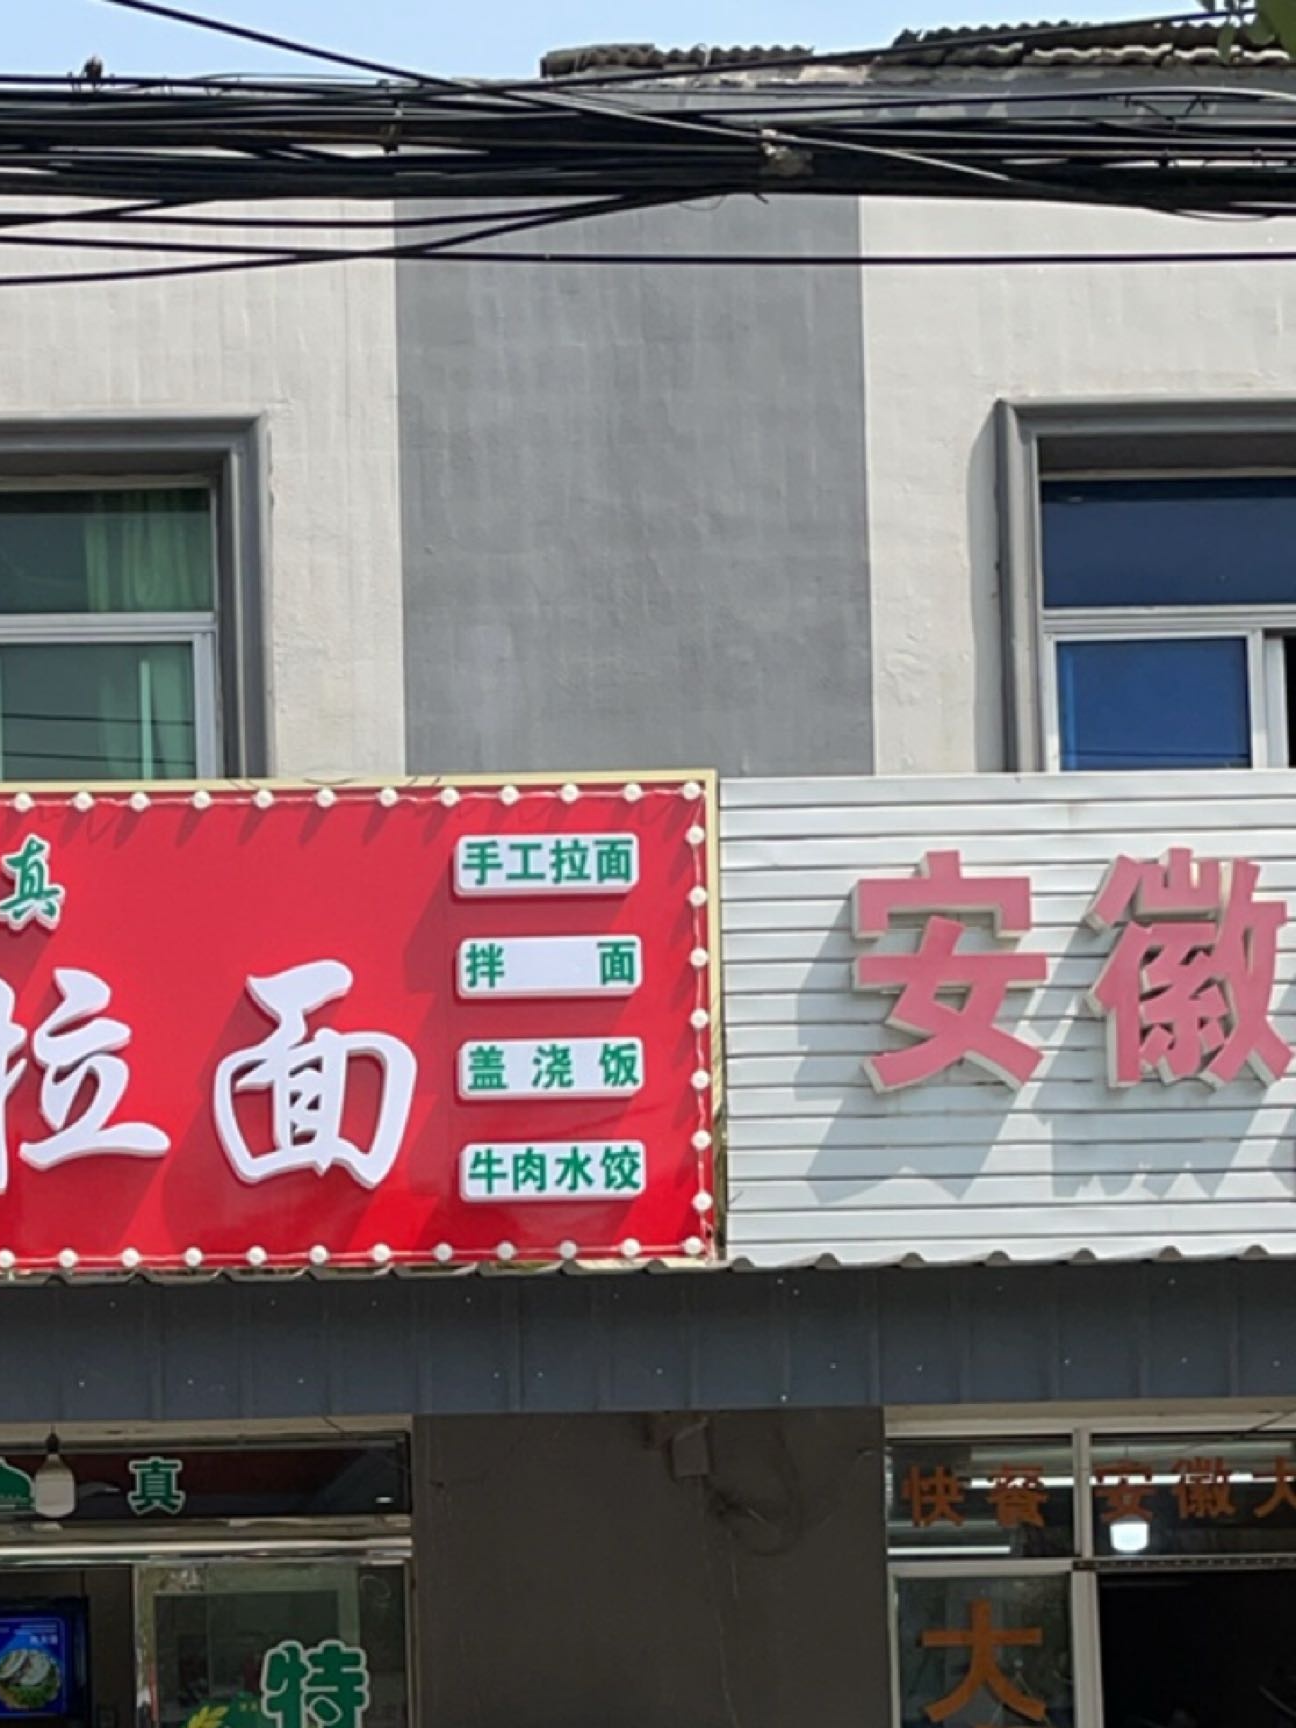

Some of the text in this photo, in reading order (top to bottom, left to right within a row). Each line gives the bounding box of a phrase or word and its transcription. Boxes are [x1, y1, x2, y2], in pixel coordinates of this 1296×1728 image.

[461, 840, 634, 885] 手工拉面
[465, 941, 636, 987] 拌面
[852, 847, 1295, 1094] 安徽
[467, 1044, 641, 1089] 盖浇饭
[467, 1147, 643, 1191] 牛肉水饺
[128, 1457, 184, 1516] 真
[904, 1464, 1047, 1528] 快餐
